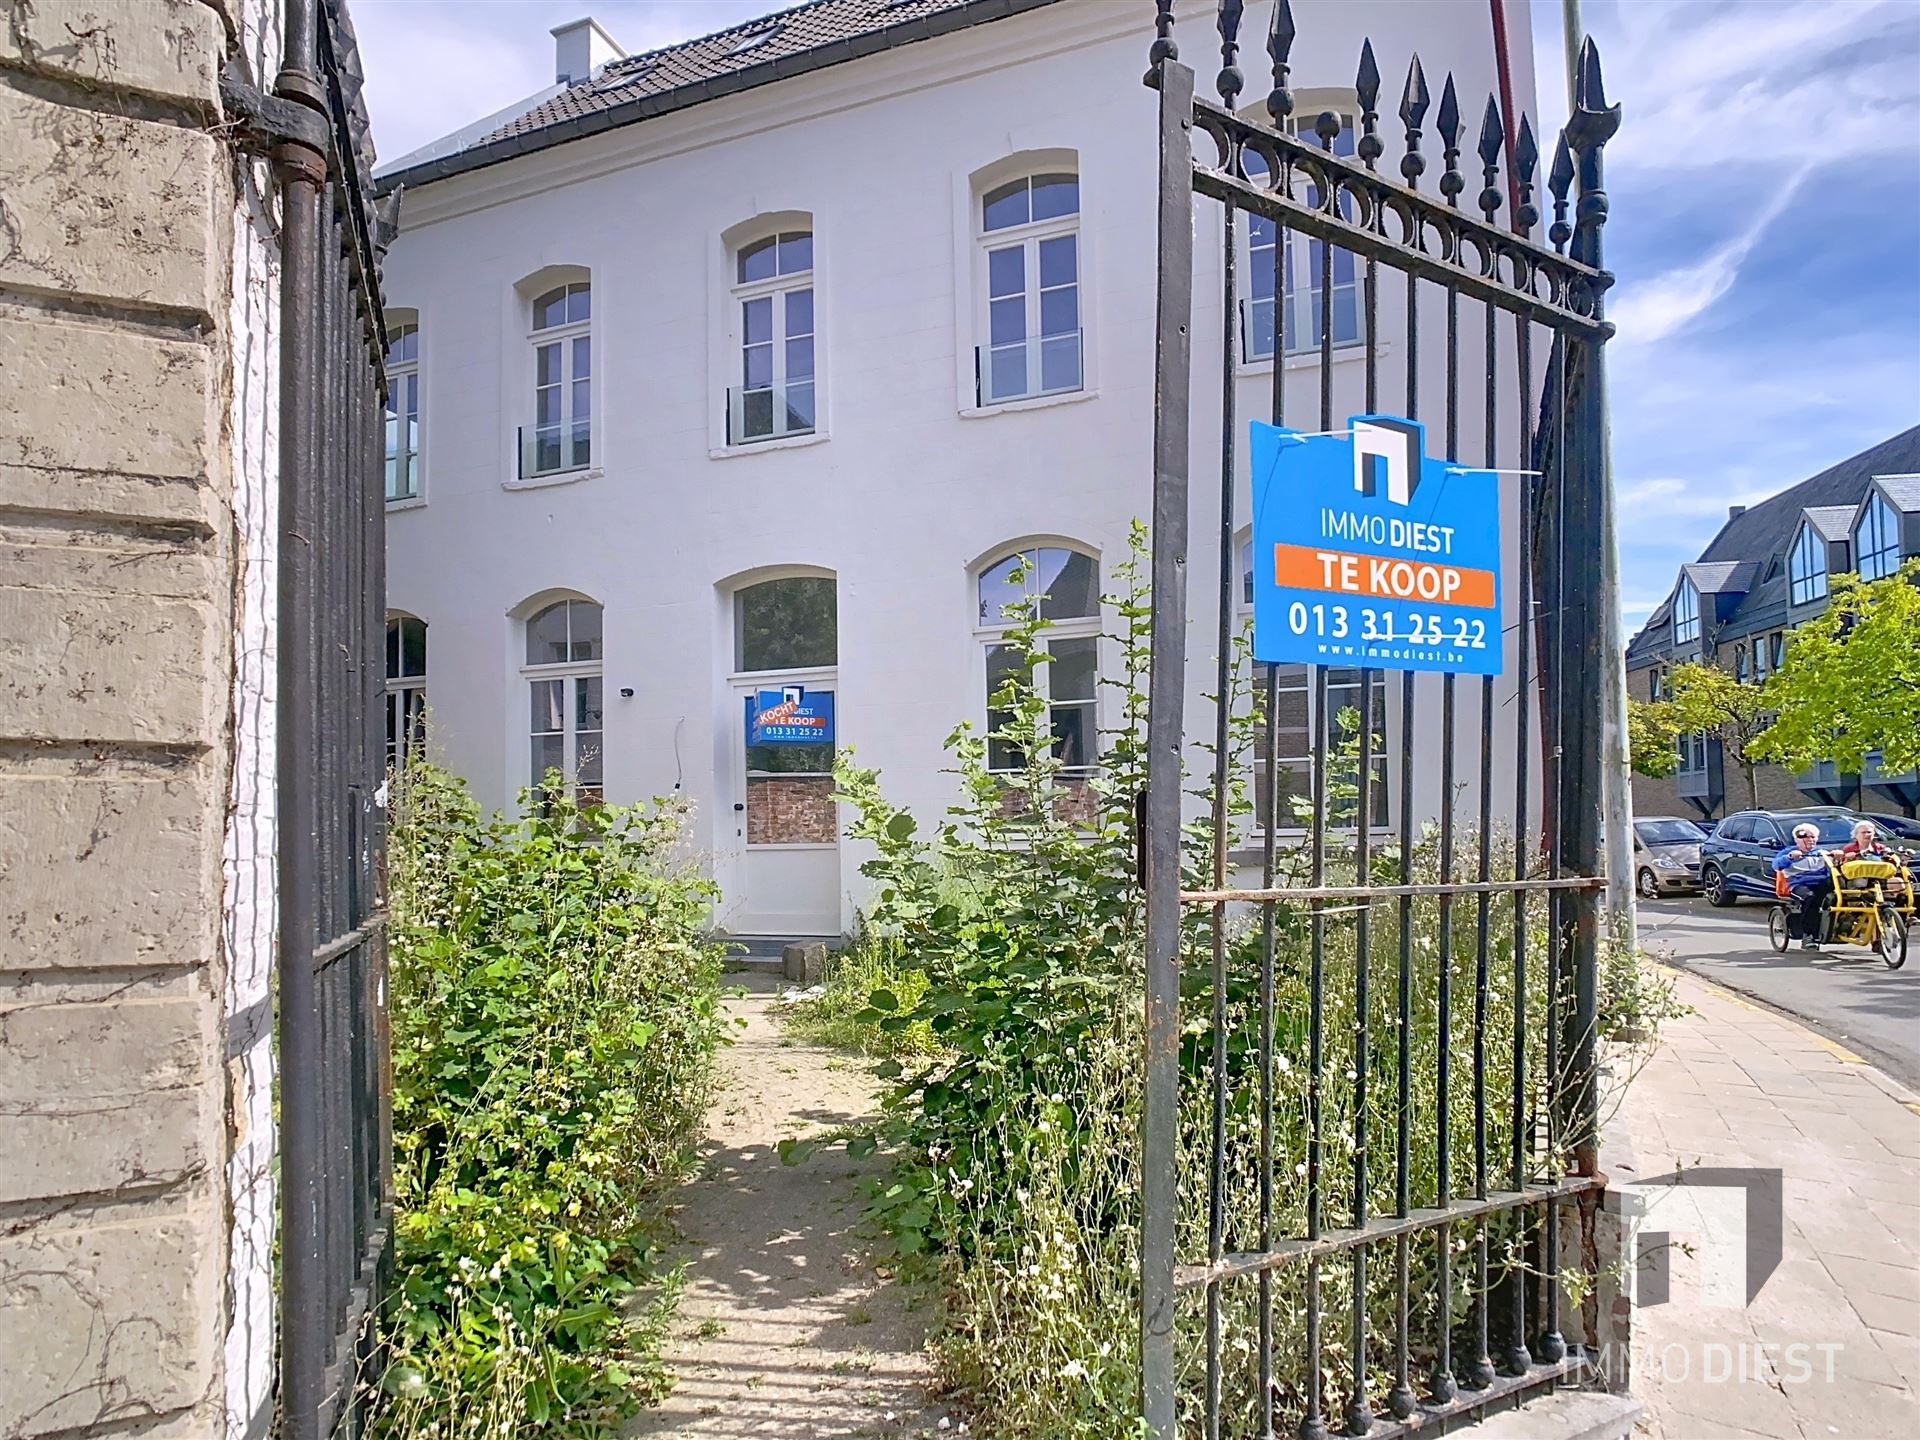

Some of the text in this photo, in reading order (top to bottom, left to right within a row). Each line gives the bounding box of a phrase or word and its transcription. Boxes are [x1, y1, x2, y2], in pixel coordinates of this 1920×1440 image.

[1321, 507, 1455, 555] IMMO DIEST
[1317, 552, 1461, 601] TE KOOP
[1289, 601, 1486, 649] 013 31 25 22
[1318, 643, 1464, 663] www.immodiest.be
[766, 726, 783, 735] 013
[785, 727, 796, 735] 31
[788, 717, 816, 725] KOOP
